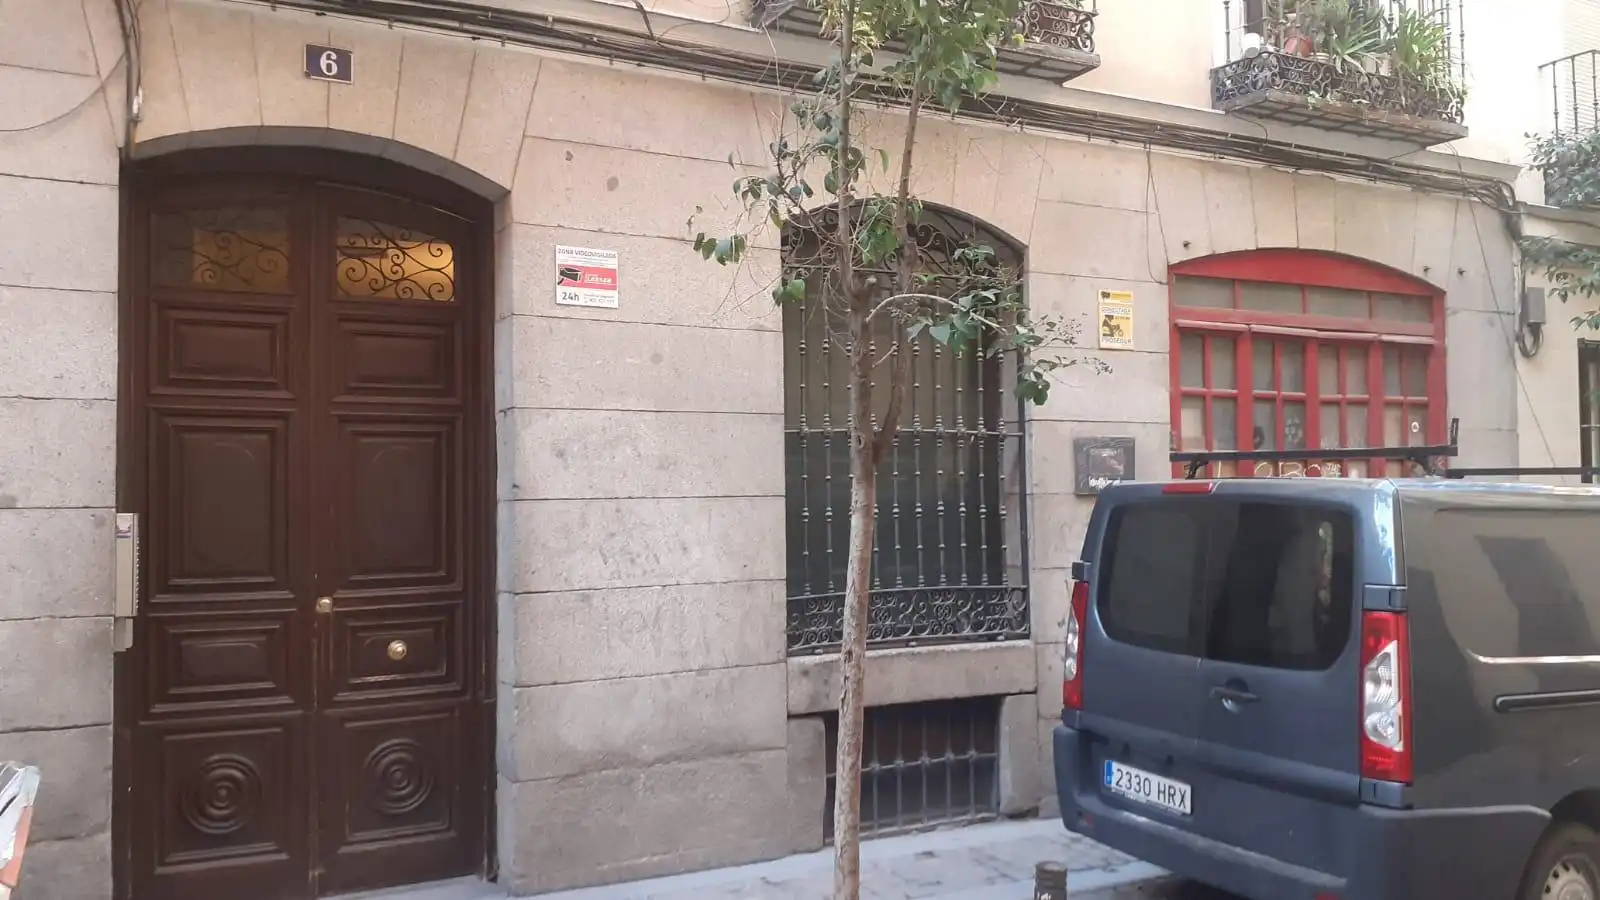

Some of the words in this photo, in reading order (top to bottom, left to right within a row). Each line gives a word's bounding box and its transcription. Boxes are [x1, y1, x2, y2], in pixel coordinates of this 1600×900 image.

[320, 50, 338, 76] 6
[561, 291, 580, 301] 24h
[1115, 768, 1152, 797] 2330
[1157, 781, 1187, 809] HRX
